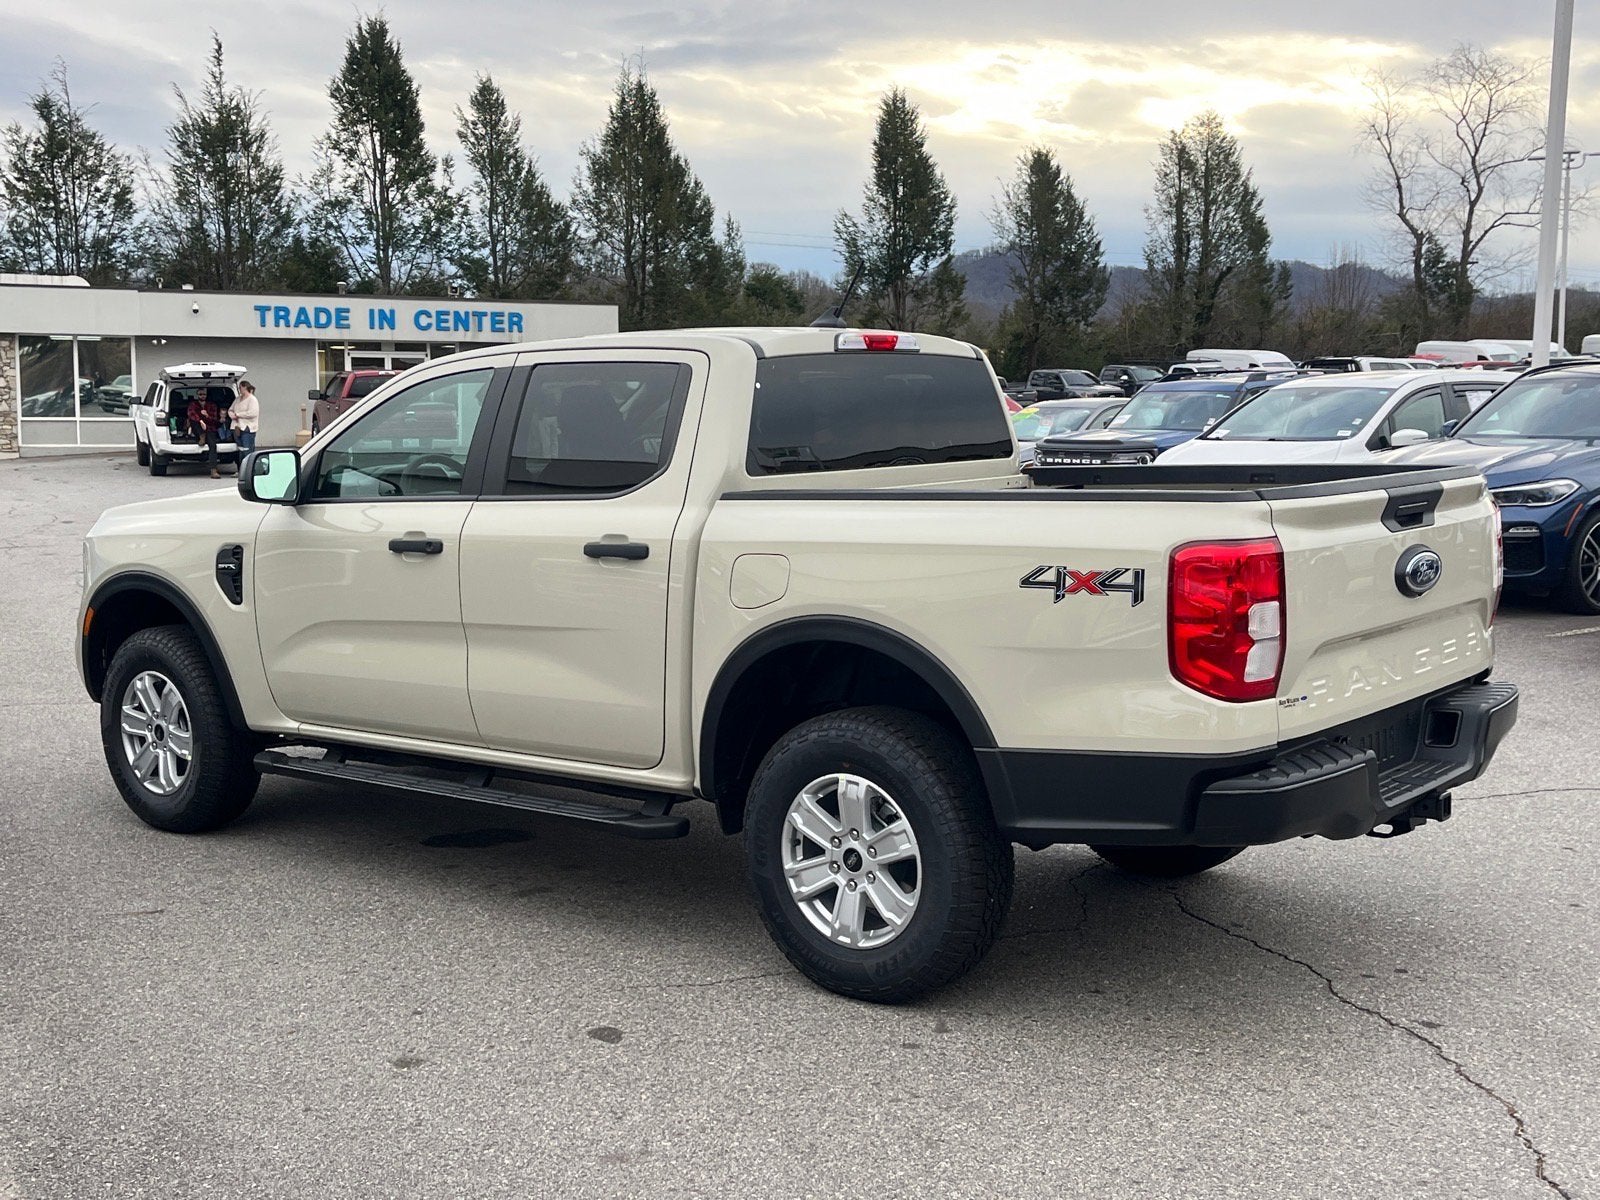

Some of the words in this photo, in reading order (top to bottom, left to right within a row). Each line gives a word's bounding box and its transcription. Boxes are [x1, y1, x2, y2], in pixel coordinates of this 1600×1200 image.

[254, 305, 350, 329] TRADE
[369, 308, 396, 330] IN
[413, 309, 523, 333] CENTER
[1046, 457, 1102, 465] BRONCO
[1019, 565, 1145, 607] 4X4
[1307, 628, 1482, 708] RANGER
